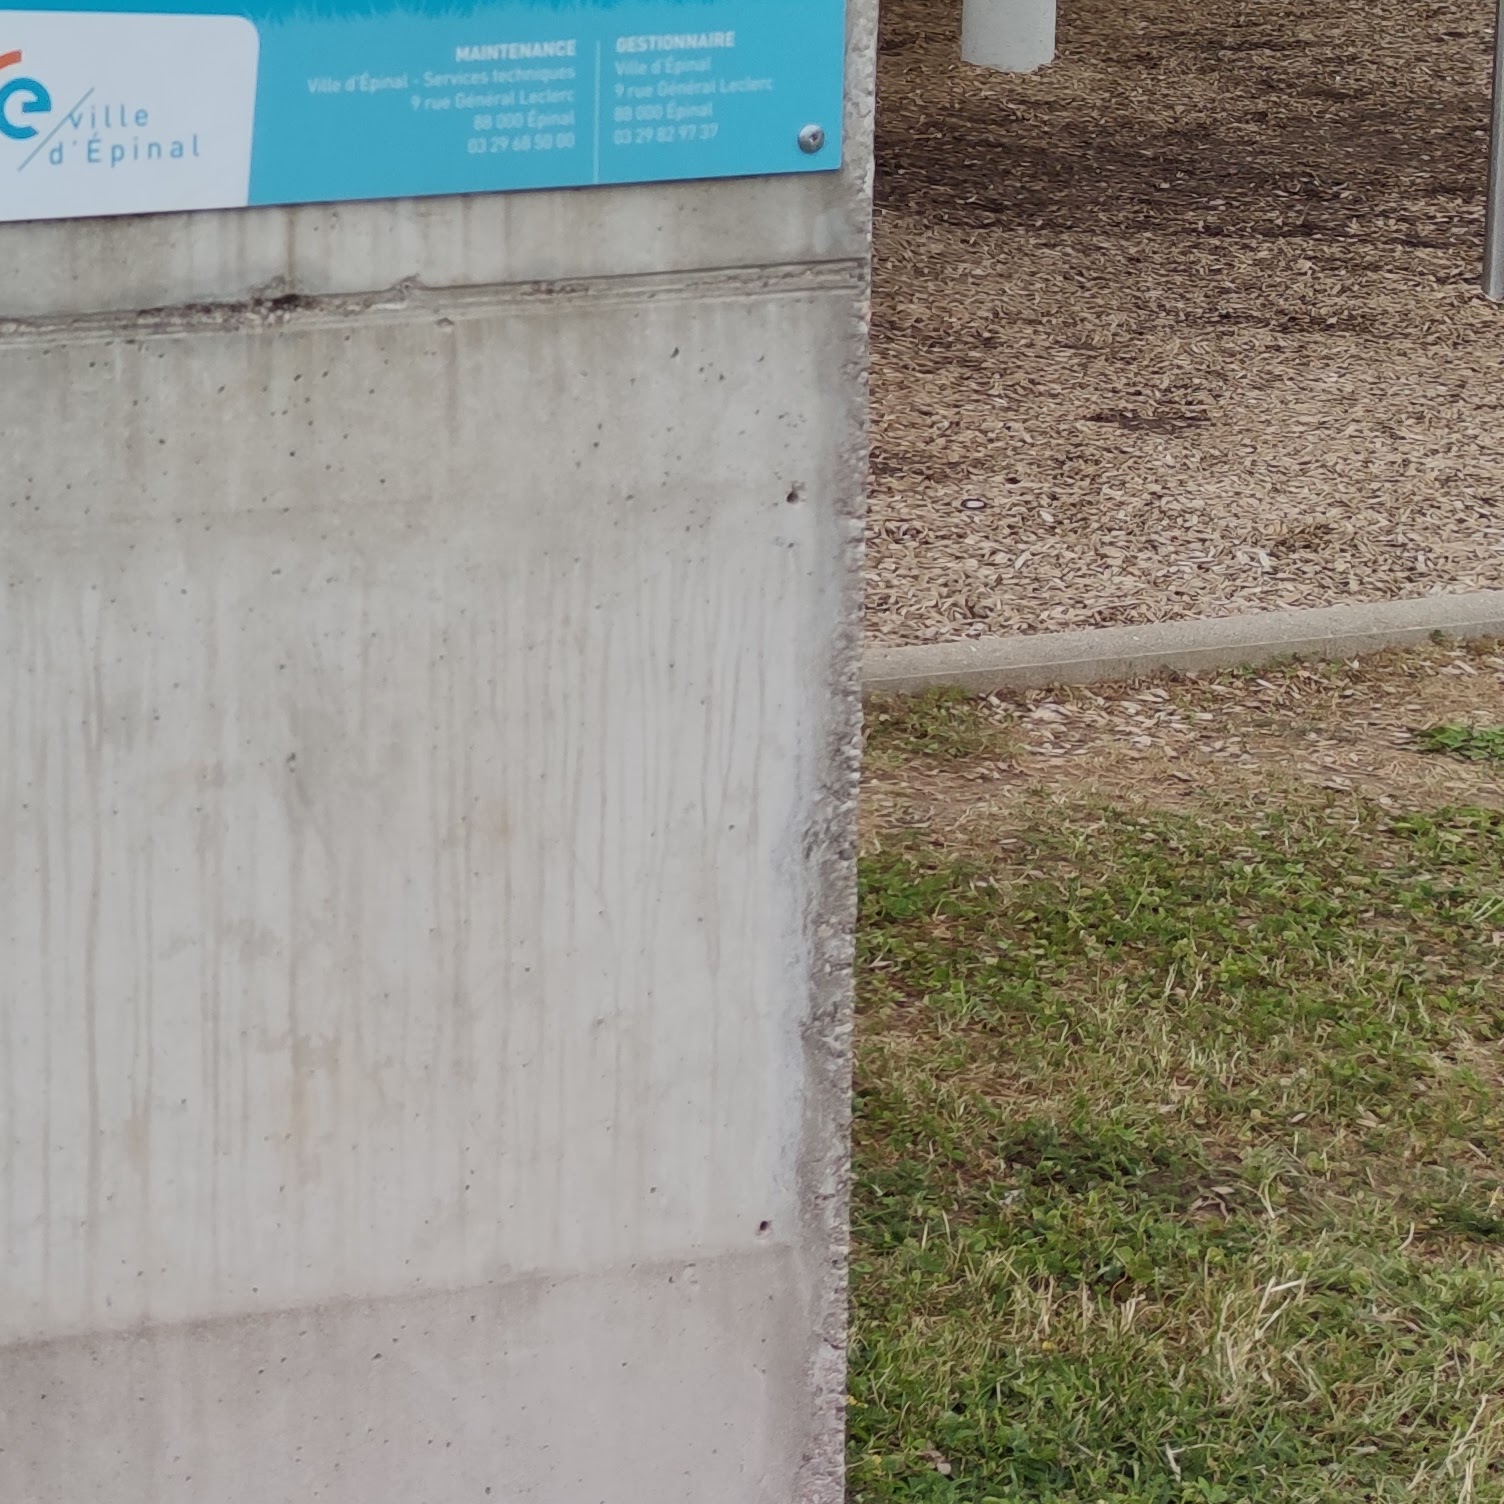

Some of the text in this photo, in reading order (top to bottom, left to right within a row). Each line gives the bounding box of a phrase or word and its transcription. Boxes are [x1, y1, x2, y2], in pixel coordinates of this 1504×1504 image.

[455, 40, 576, 62] MAINTENANCE
[616, 31, 735, 53] GESTIONNAIRE
[67, 103, 149, 130] ville
[49, 132, 200, 168] d'Épinal
